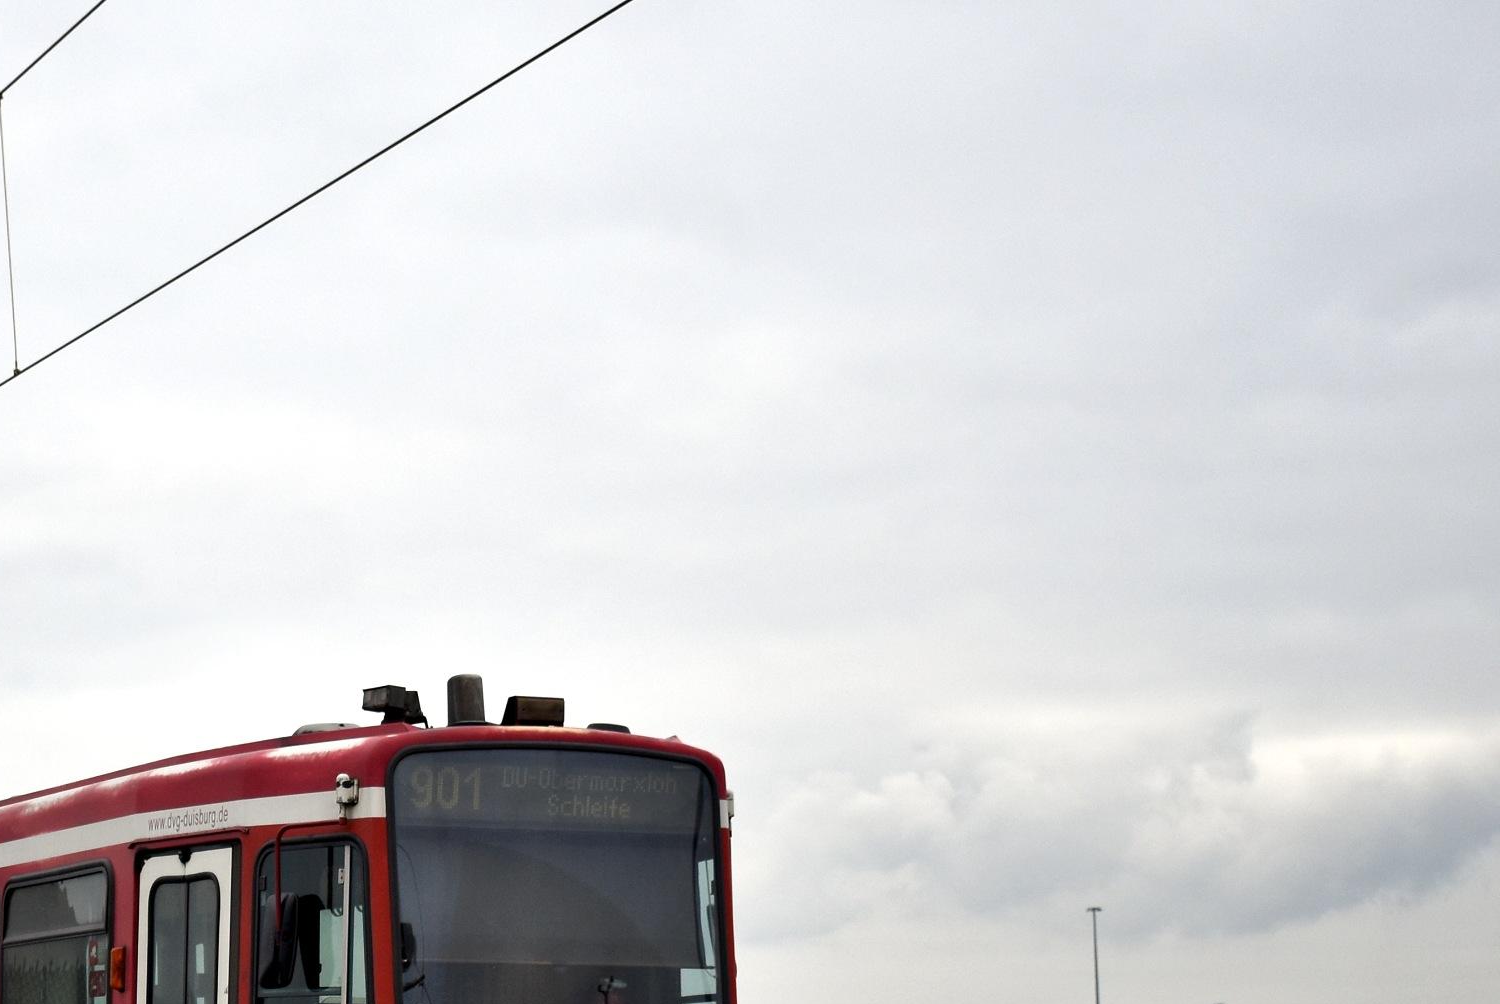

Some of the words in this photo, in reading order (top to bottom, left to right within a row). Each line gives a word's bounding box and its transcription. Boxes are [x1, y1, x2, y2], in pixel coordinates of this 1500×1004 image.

[410, 766, 481, 810] 901
[501, 767, 678, 794] DU-Obermarxloh
[148, 806, 229, 833] www.dvg-duisburg.de
[547, 794, 631, 819] Schleife
